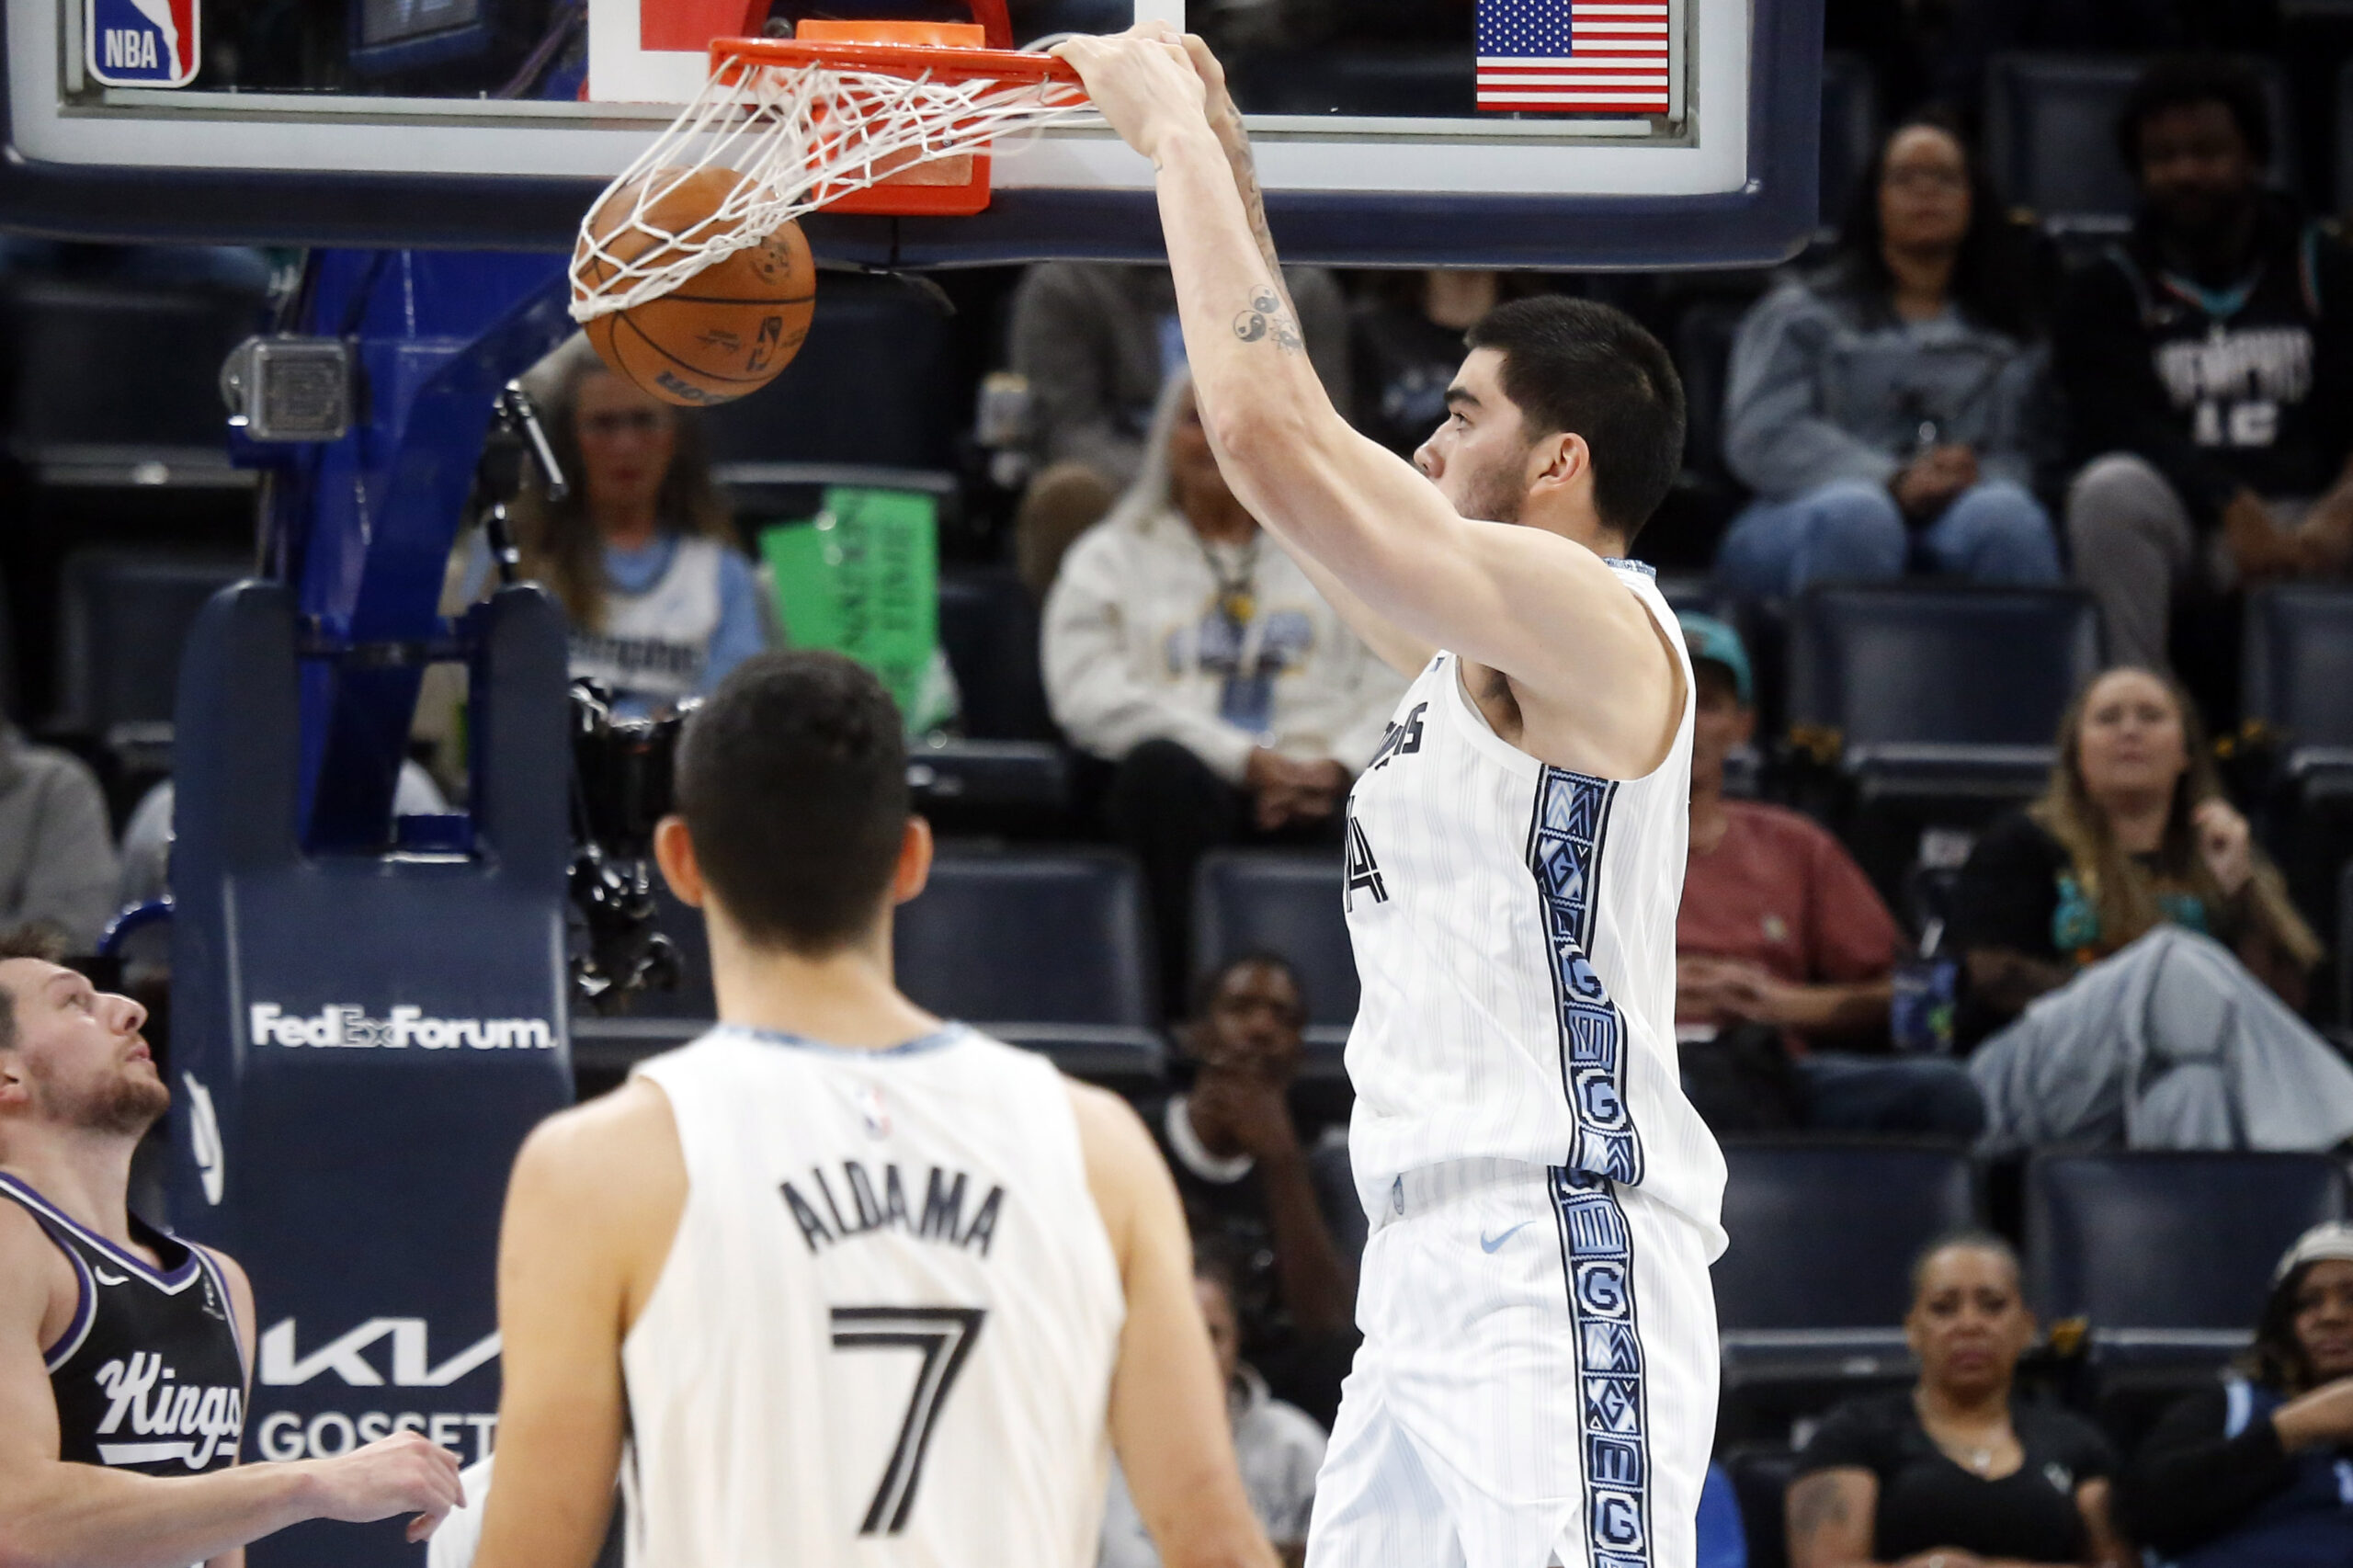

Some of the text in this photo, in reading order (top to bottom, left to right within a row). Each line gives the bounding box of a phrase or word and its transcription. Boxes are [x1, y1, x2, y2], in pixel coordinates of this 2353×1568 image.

[105, 28, 157, 69] NBA
[1346, 795, 1389, 913] 4
[779, 1159, 1005, 1258] ALDAMA
[95, 1350, 243, 1471] Kings
[829, 1306, 986, 1537] 7
